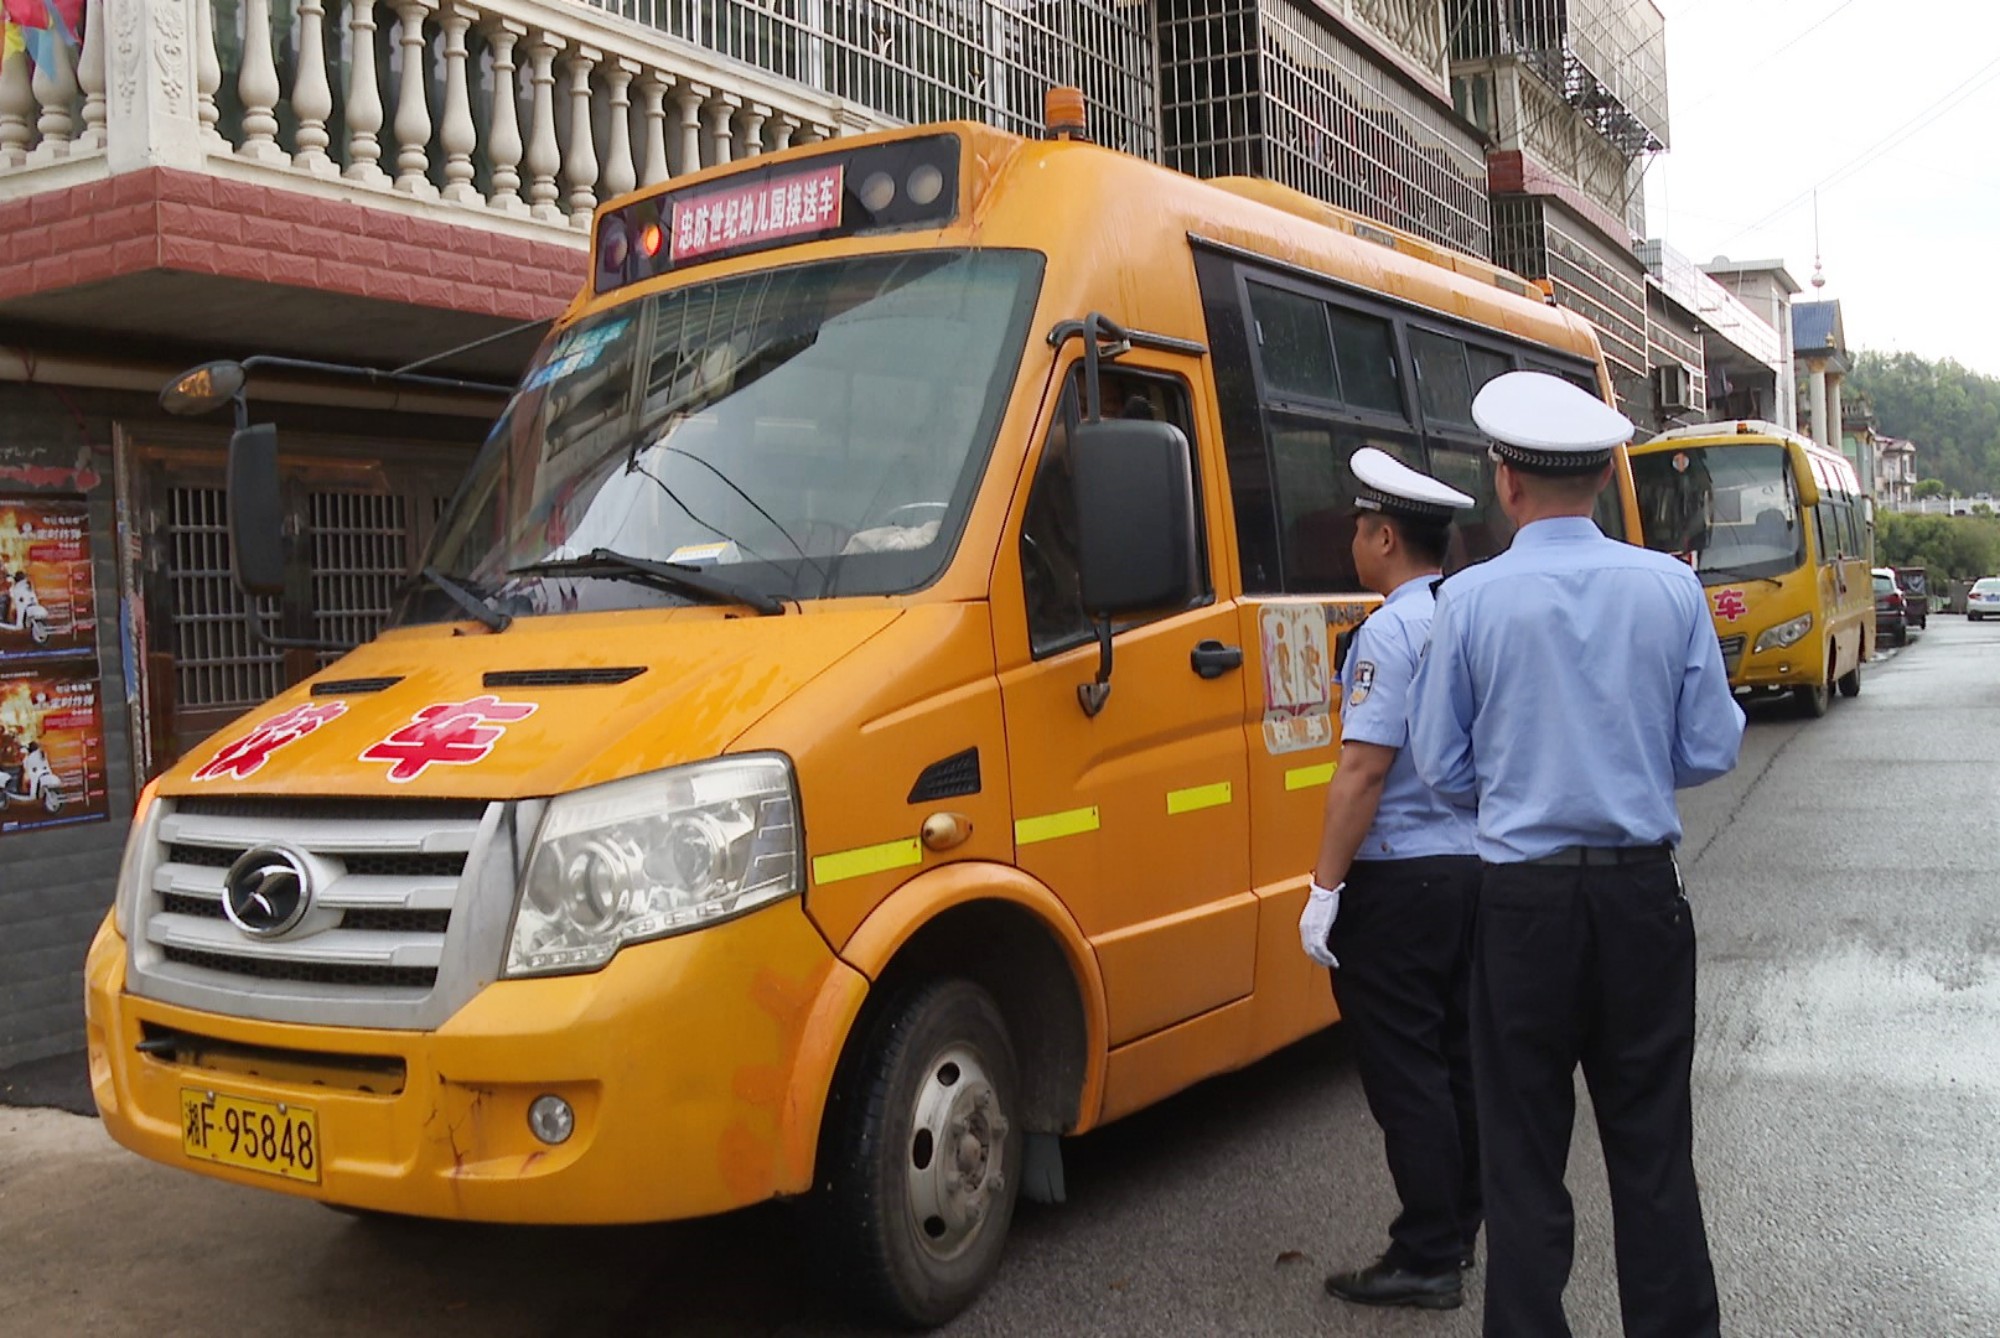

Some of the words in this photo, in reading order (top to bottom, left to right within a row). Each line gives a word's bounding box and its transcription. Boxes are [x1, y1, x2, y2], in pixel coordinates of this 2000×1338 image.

[678, 176, 835, 250] 忠防世纪幼儿园接送车
[1712, 587, 1748, 623] 车
